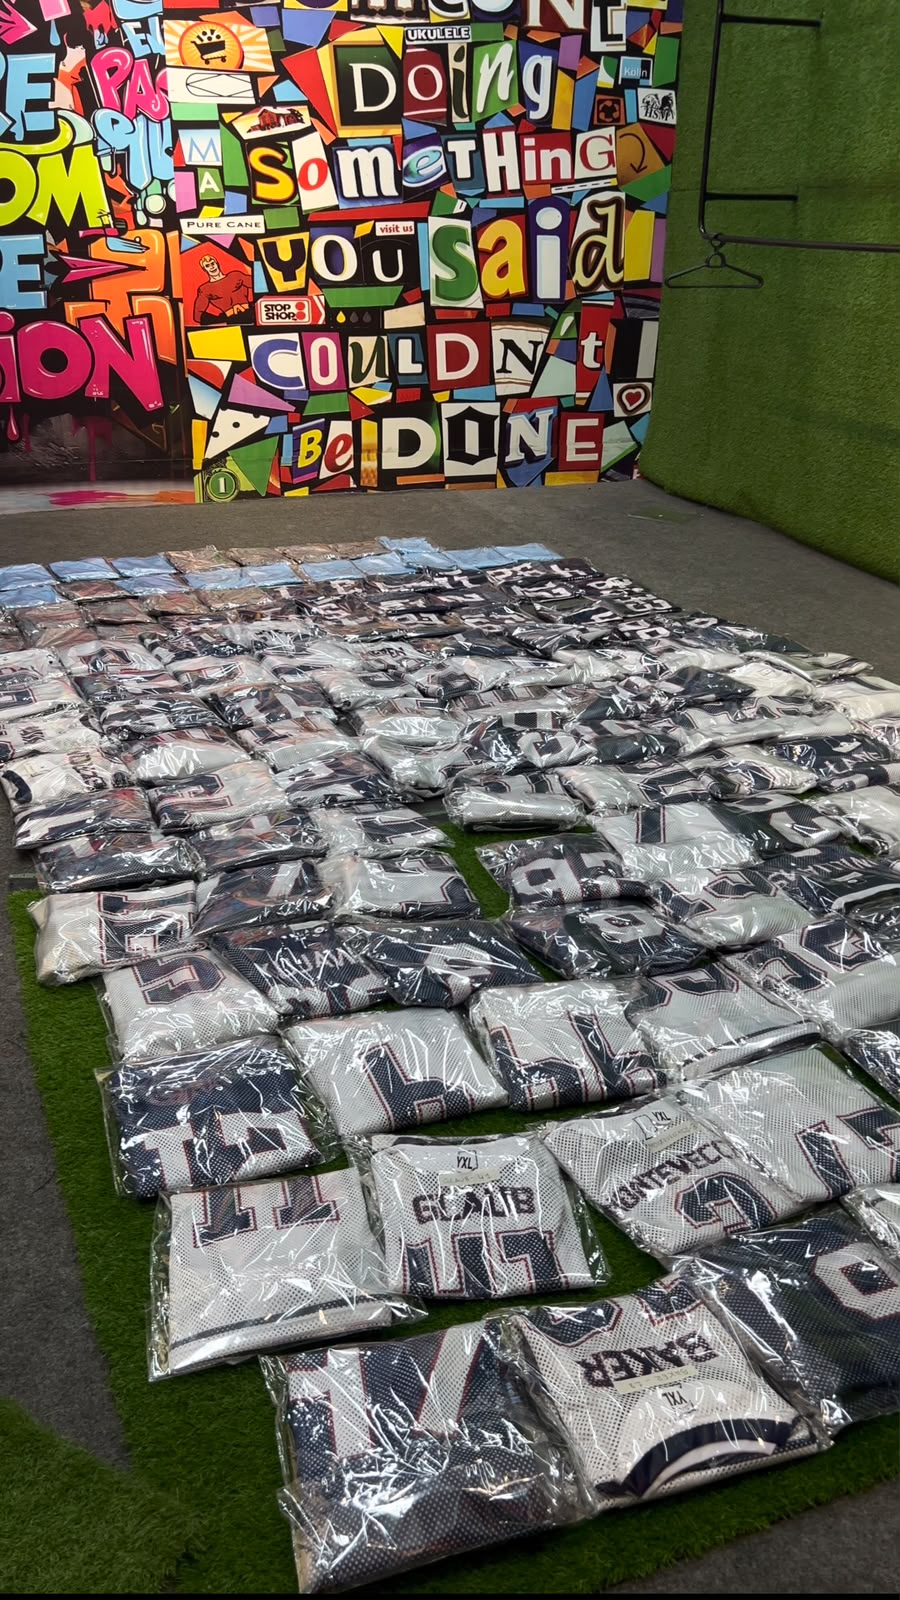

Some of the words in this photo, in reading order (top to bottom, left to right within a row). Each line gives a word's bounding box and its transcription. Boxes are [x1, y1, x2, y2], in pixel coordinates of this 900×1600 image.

[407, 26, 471, 41] UKULELE
[380, 223, 400, 233] visit
[402, 225, 413, 233] us
[264, 303, 291, 313] STOP
[265, 312, 296, 321] SHOP
[381, 405, 600, 470] DONE
[651, 1111, 671, 1122] YXL
[456, 1156, 474, 1170] YXL
[575, 1330, 719, 1390] BAKER
[661, 1390, 688, 1406] YXL
